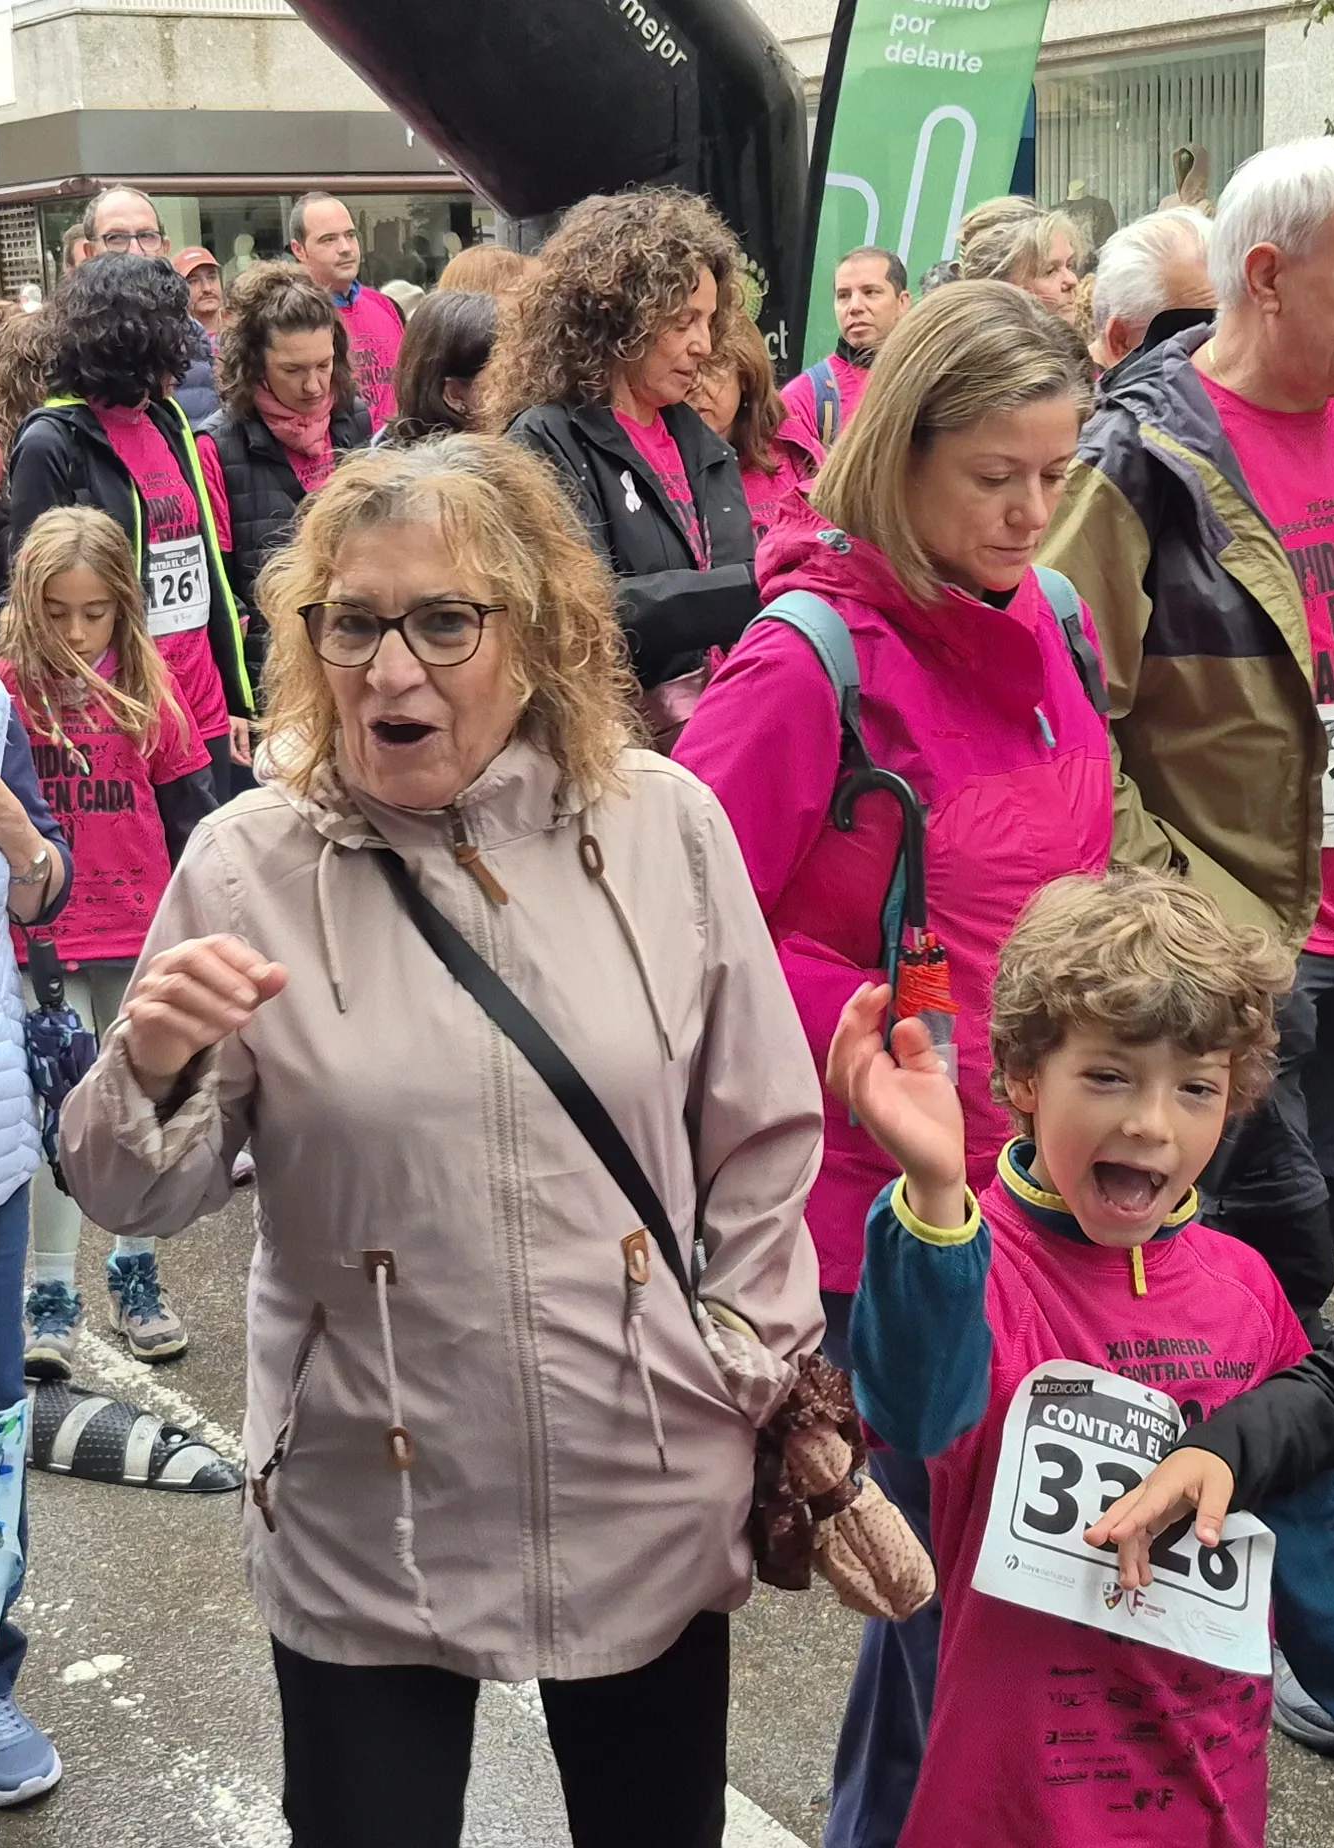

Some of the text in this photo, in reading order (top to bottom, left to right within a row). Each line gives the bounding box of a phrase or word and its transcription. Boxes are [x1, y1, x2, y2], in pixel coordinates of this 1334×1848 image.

[618, 0, 688, 68] mejor
[889, 12, 936, 37] por
[884, 40, 983, 74] delante
[43, 779, 135, 814] EN CADA
[1106, 1338, 1212, 1362] XII CARRERA
[1034, 1383, 1049, 1394] XII
[1119, 1363, 1187, 1385] CONTRA
[1192, 1361, 1212, 1380] EL
[1042, 1403, 1163, 1462] CONTRA EL
[1126, 1408, 1175, 1443] HUESCA
